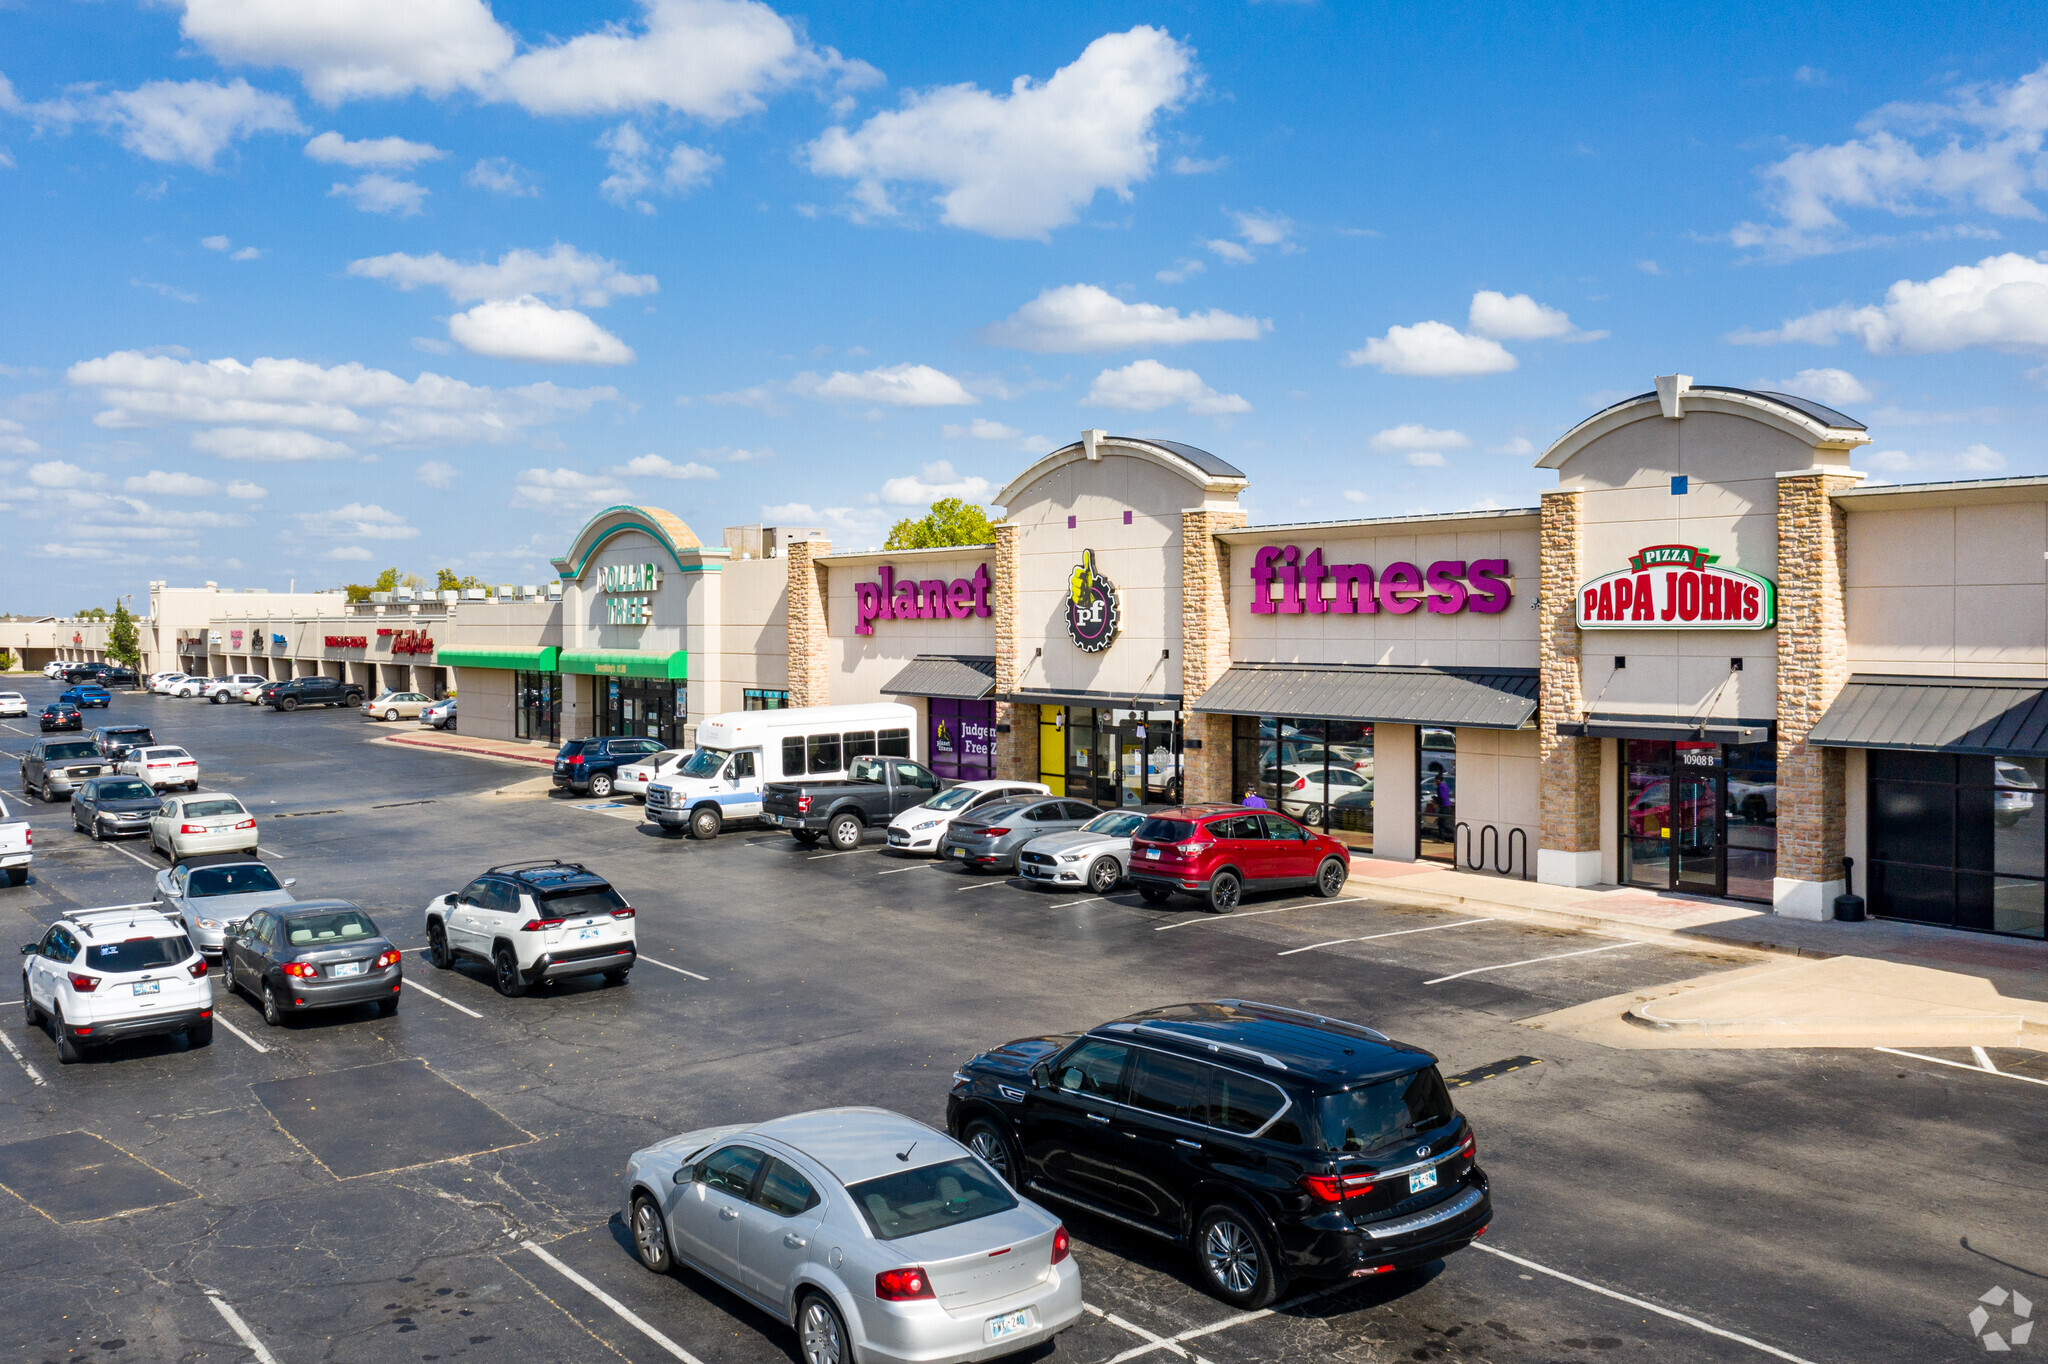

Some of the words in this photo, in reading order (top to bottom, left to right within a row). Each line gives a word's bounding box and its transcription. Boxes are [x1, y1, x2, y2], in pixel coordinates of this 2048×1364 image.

[1645, 547, 1691, 564] PIZZA
[597, 563, 657, 593] DOLLAR
[1250, 545, 1512, 615] fitness
[855, 563, 991, 635] planet
[1583, 573, 1655, 621] PAPA
[1661, 571, 1759, 622] JOHN'S
[606, 597, 647, 624] TREE
[1076, 600, 1105, 626] pf
[965, 740, 988, 754] Free
[1683, 754, 1707, 766] 10908
[1708, 756, 1714, 766] B
